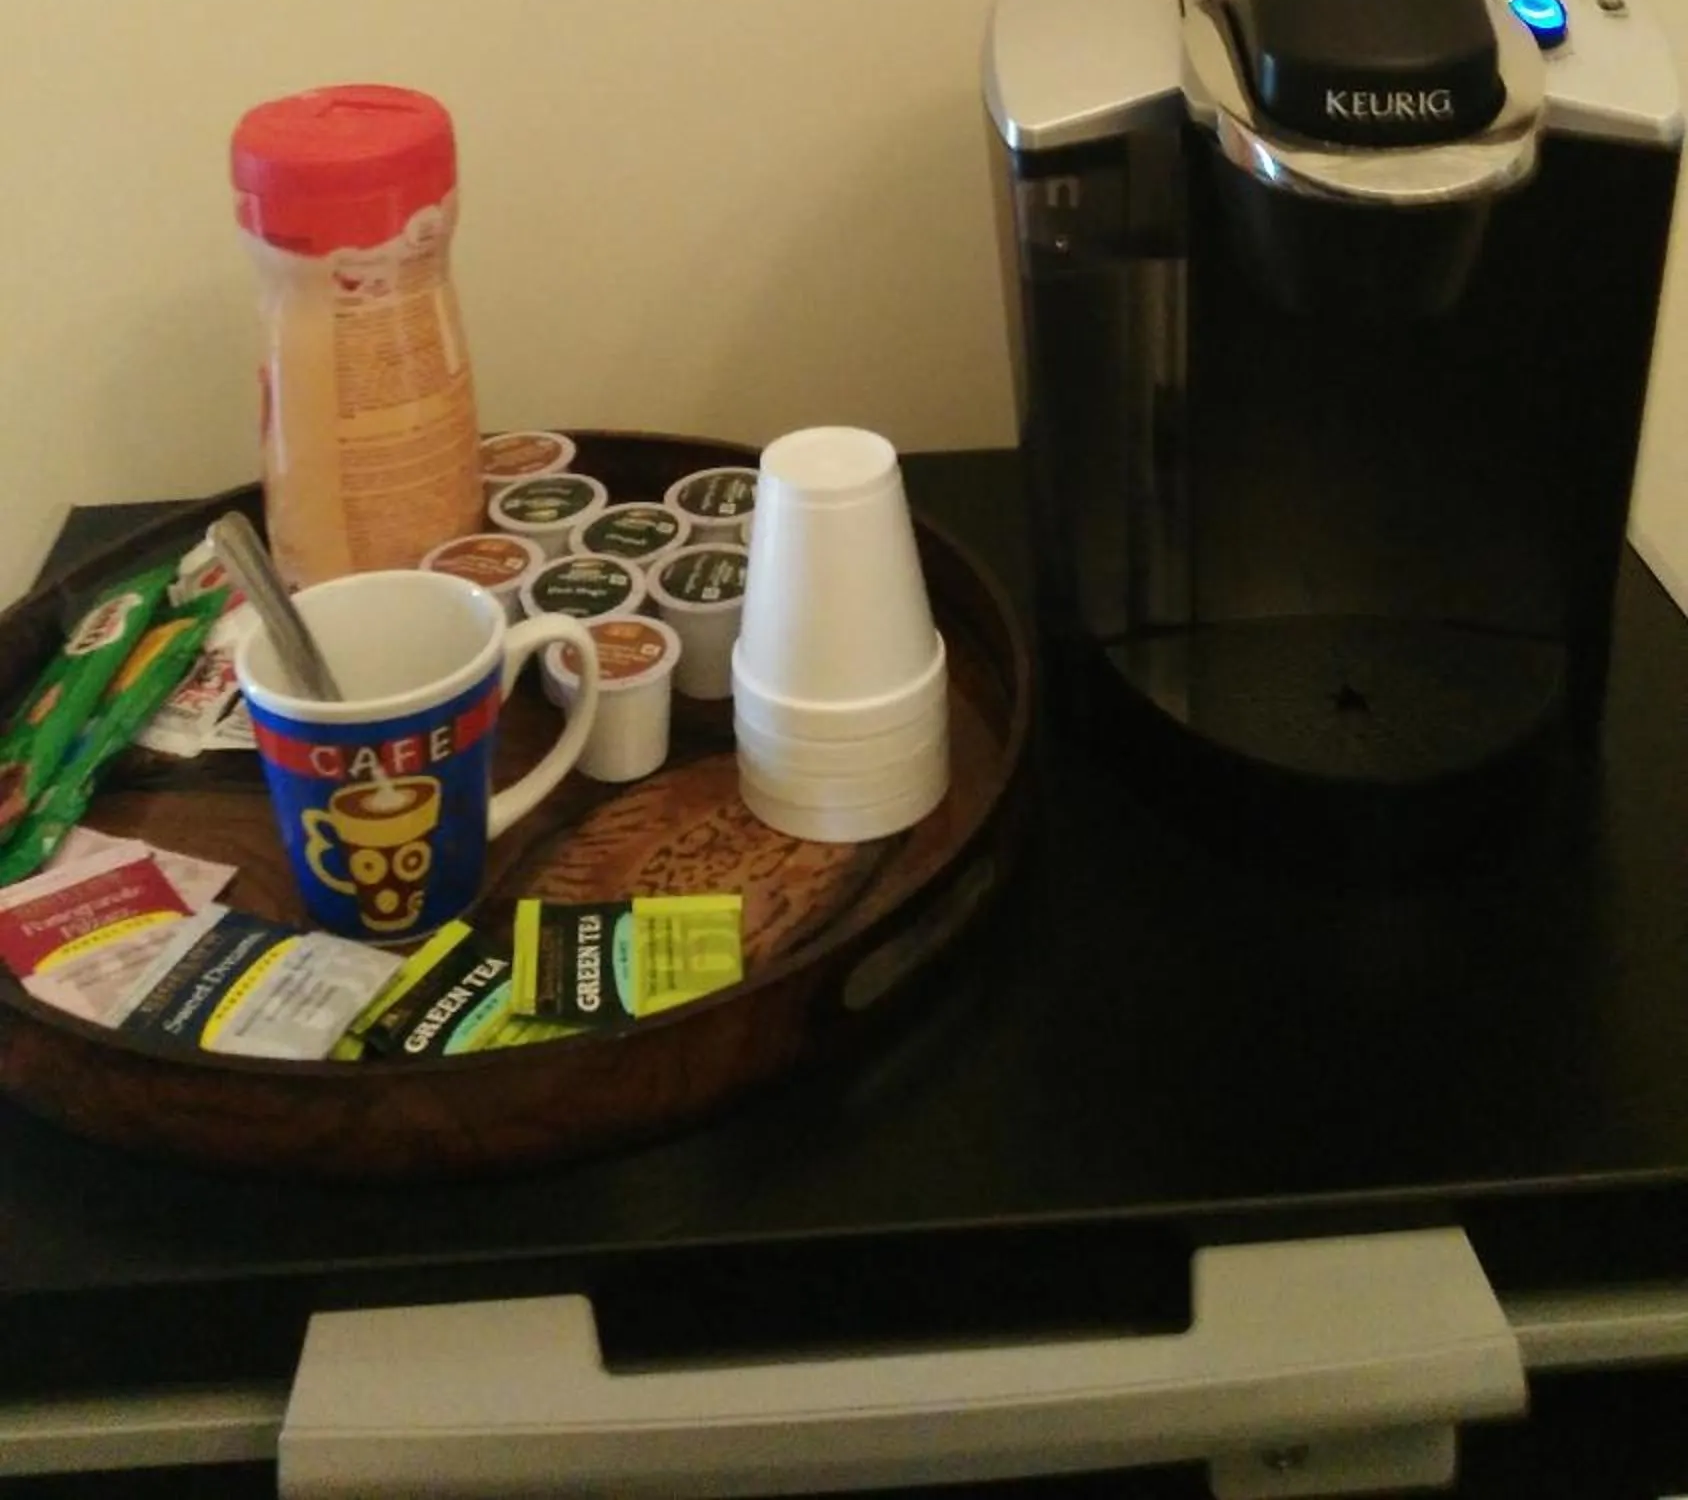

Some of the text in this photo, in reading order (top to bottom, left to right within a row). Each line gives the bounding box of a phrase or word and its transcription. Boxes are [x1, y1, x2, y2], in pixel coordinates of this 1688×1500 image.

[1325, 88, 1454, 118] KEURIG
[308, 725, 451, 779] CAFE
[577, 914, 602, 1012] GREEN TEA
[403, 985, 475, 1053] GREEN
[461, 957, 510, 988] TEA
